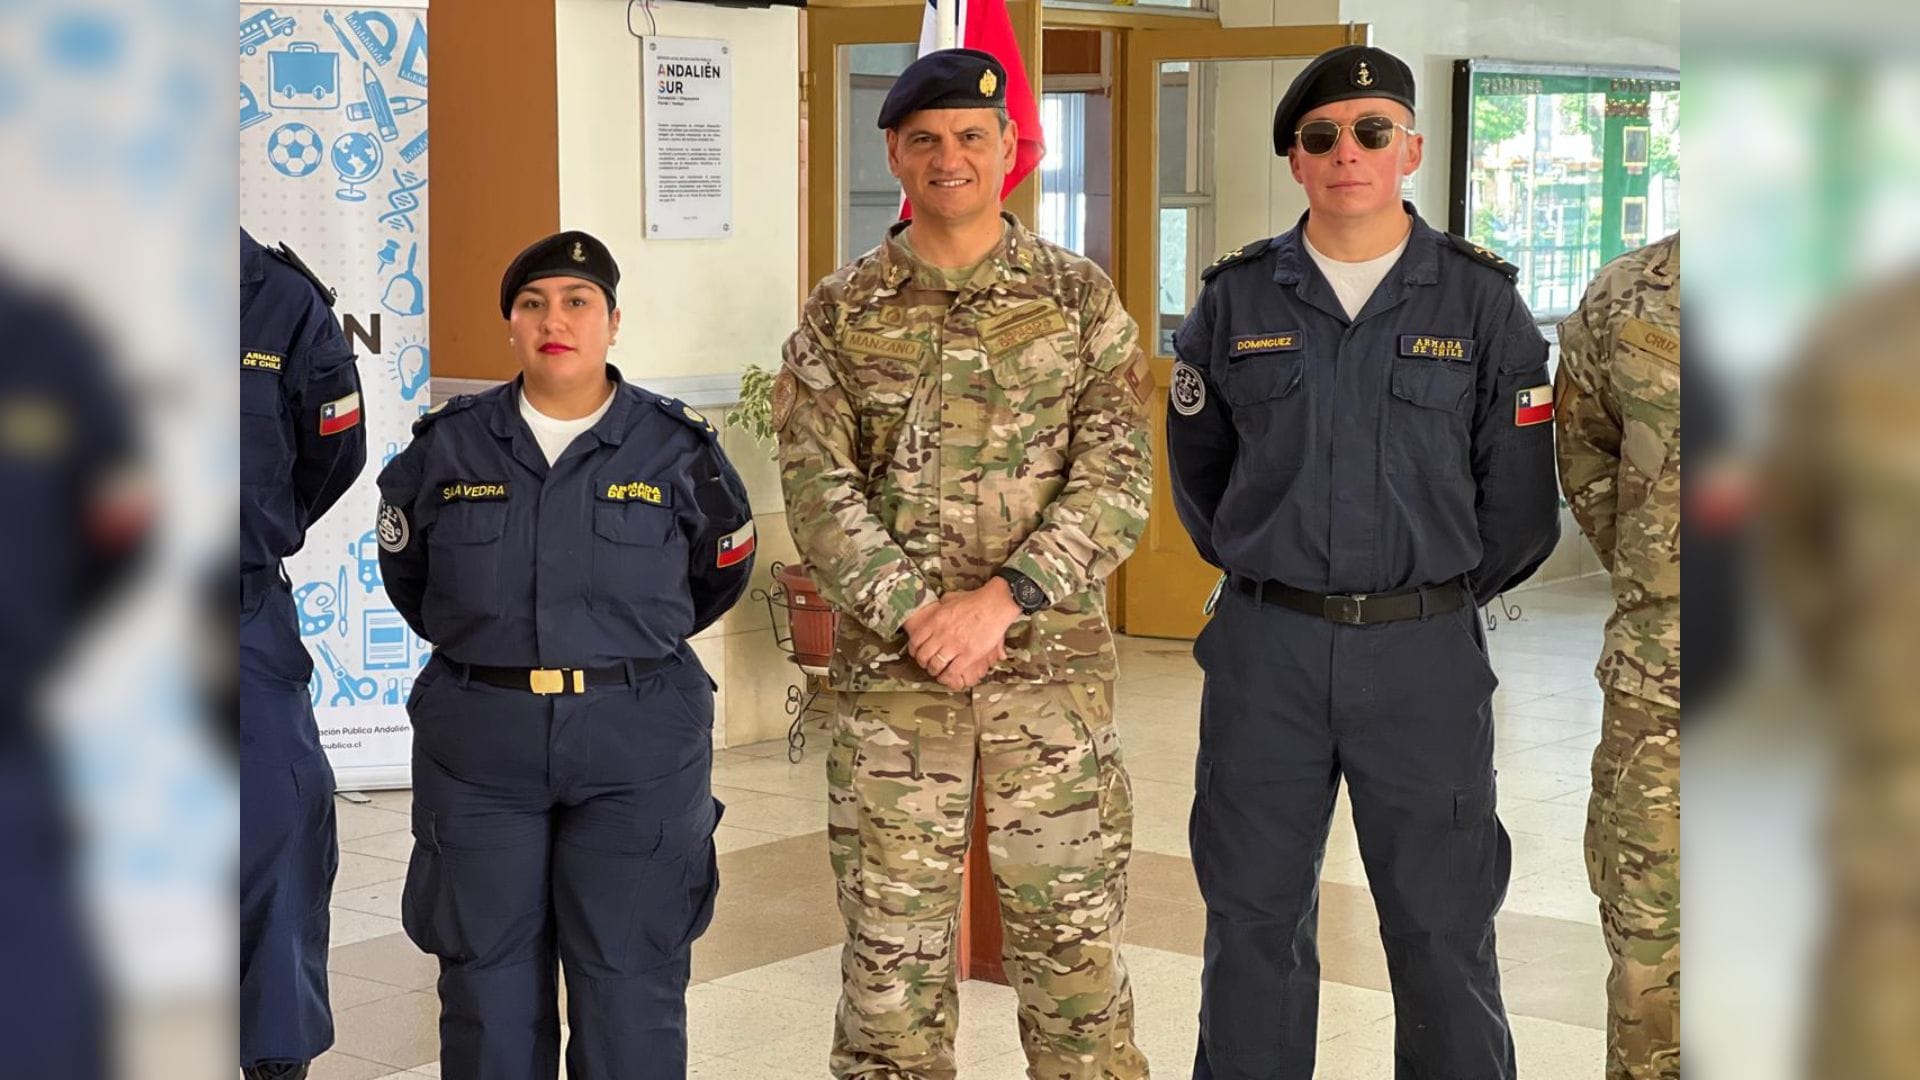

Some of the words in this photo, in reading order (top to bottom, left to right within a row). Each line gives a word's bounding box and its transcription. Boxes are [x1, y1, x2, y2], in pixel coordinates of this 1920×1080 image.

[657, 61, 720, 79] ANDALIÉN
[658, 80, 684, 94] SUR
[849, 333, 916, 355] MANZANO
[1237, 337, 1292, 351] DOMINGUEZ
[1415, 338, 1462, 350] ARMADA
[1644, 332, 1678, 354] CRUZ
[1412, 345, 1427, 353] DE
[1432, 348, 1464, 358] CHILE
[243, 358, 257, 367] DE
[607, 488, 625, 500] DE
[628, 489, 662, 503] CHILE
